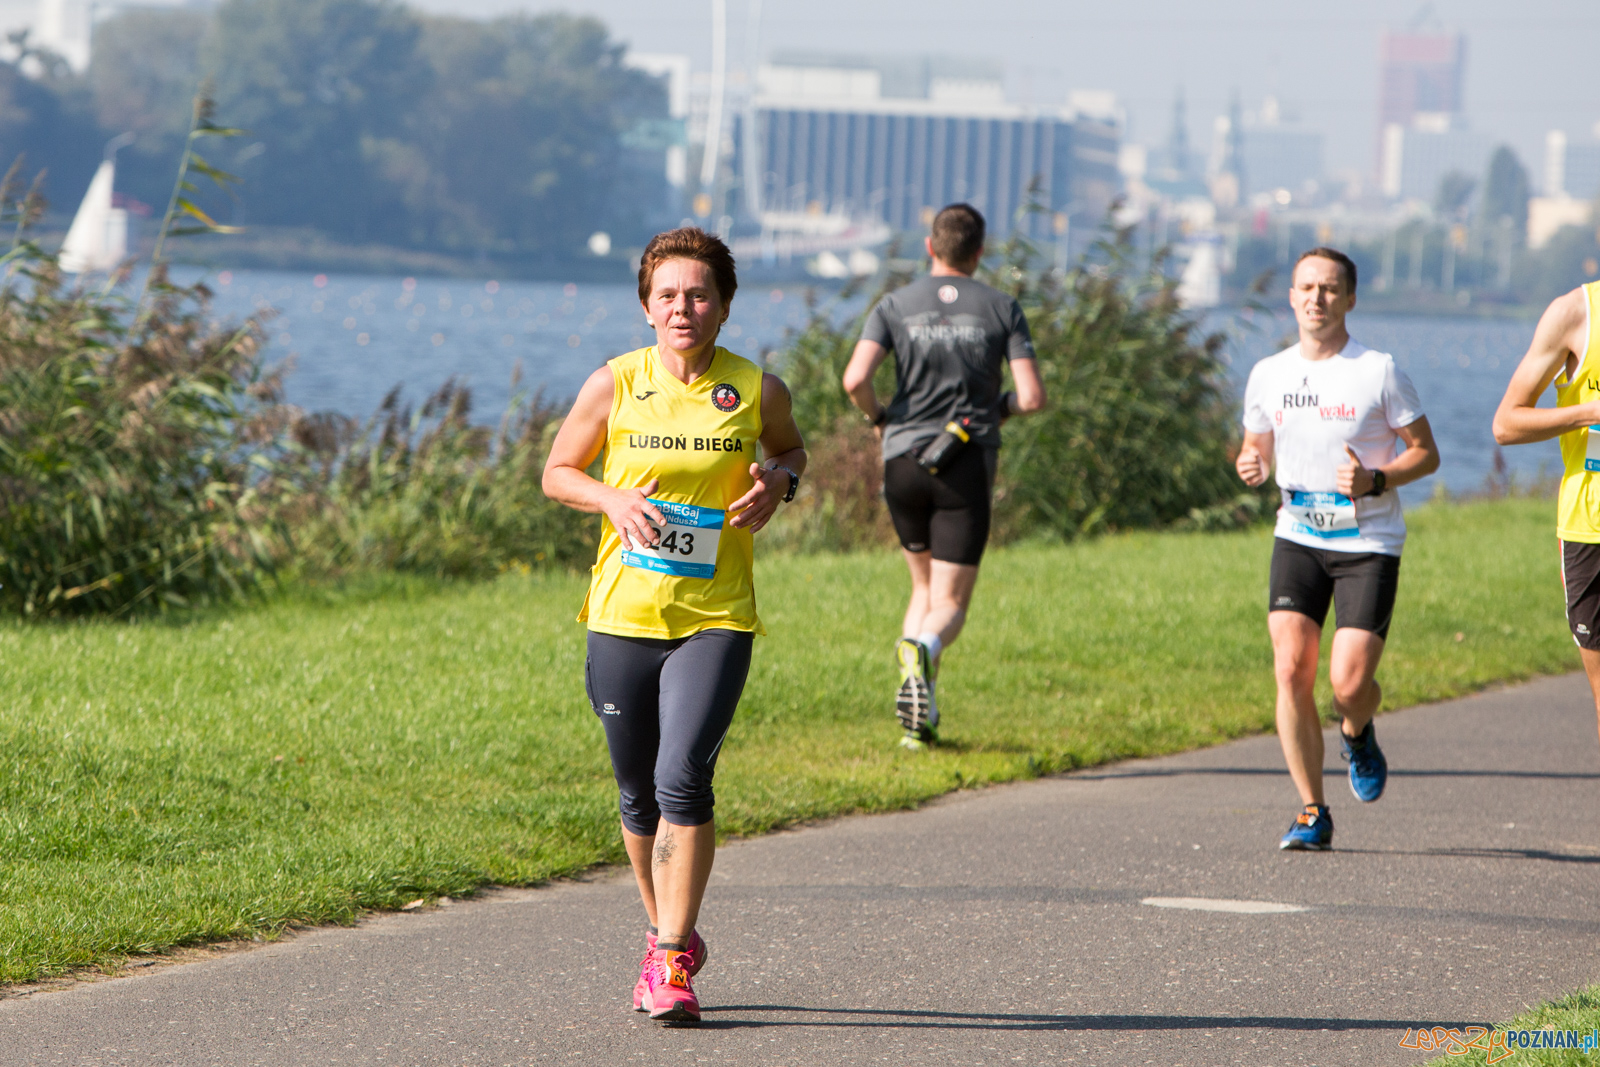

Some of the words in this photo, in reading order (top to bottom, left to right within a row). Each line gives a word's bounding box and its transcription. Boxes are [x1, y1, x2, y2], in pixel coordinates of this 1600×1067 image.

[908, 325, 986, 341] FINISHER
[1283, 393, 1319, 408] RUN
[629, 433, 687, 451] LUBOŃ
[694, 437, 744, 453] BIEGA
[652, 502, 700, 520] aBIEGaj
